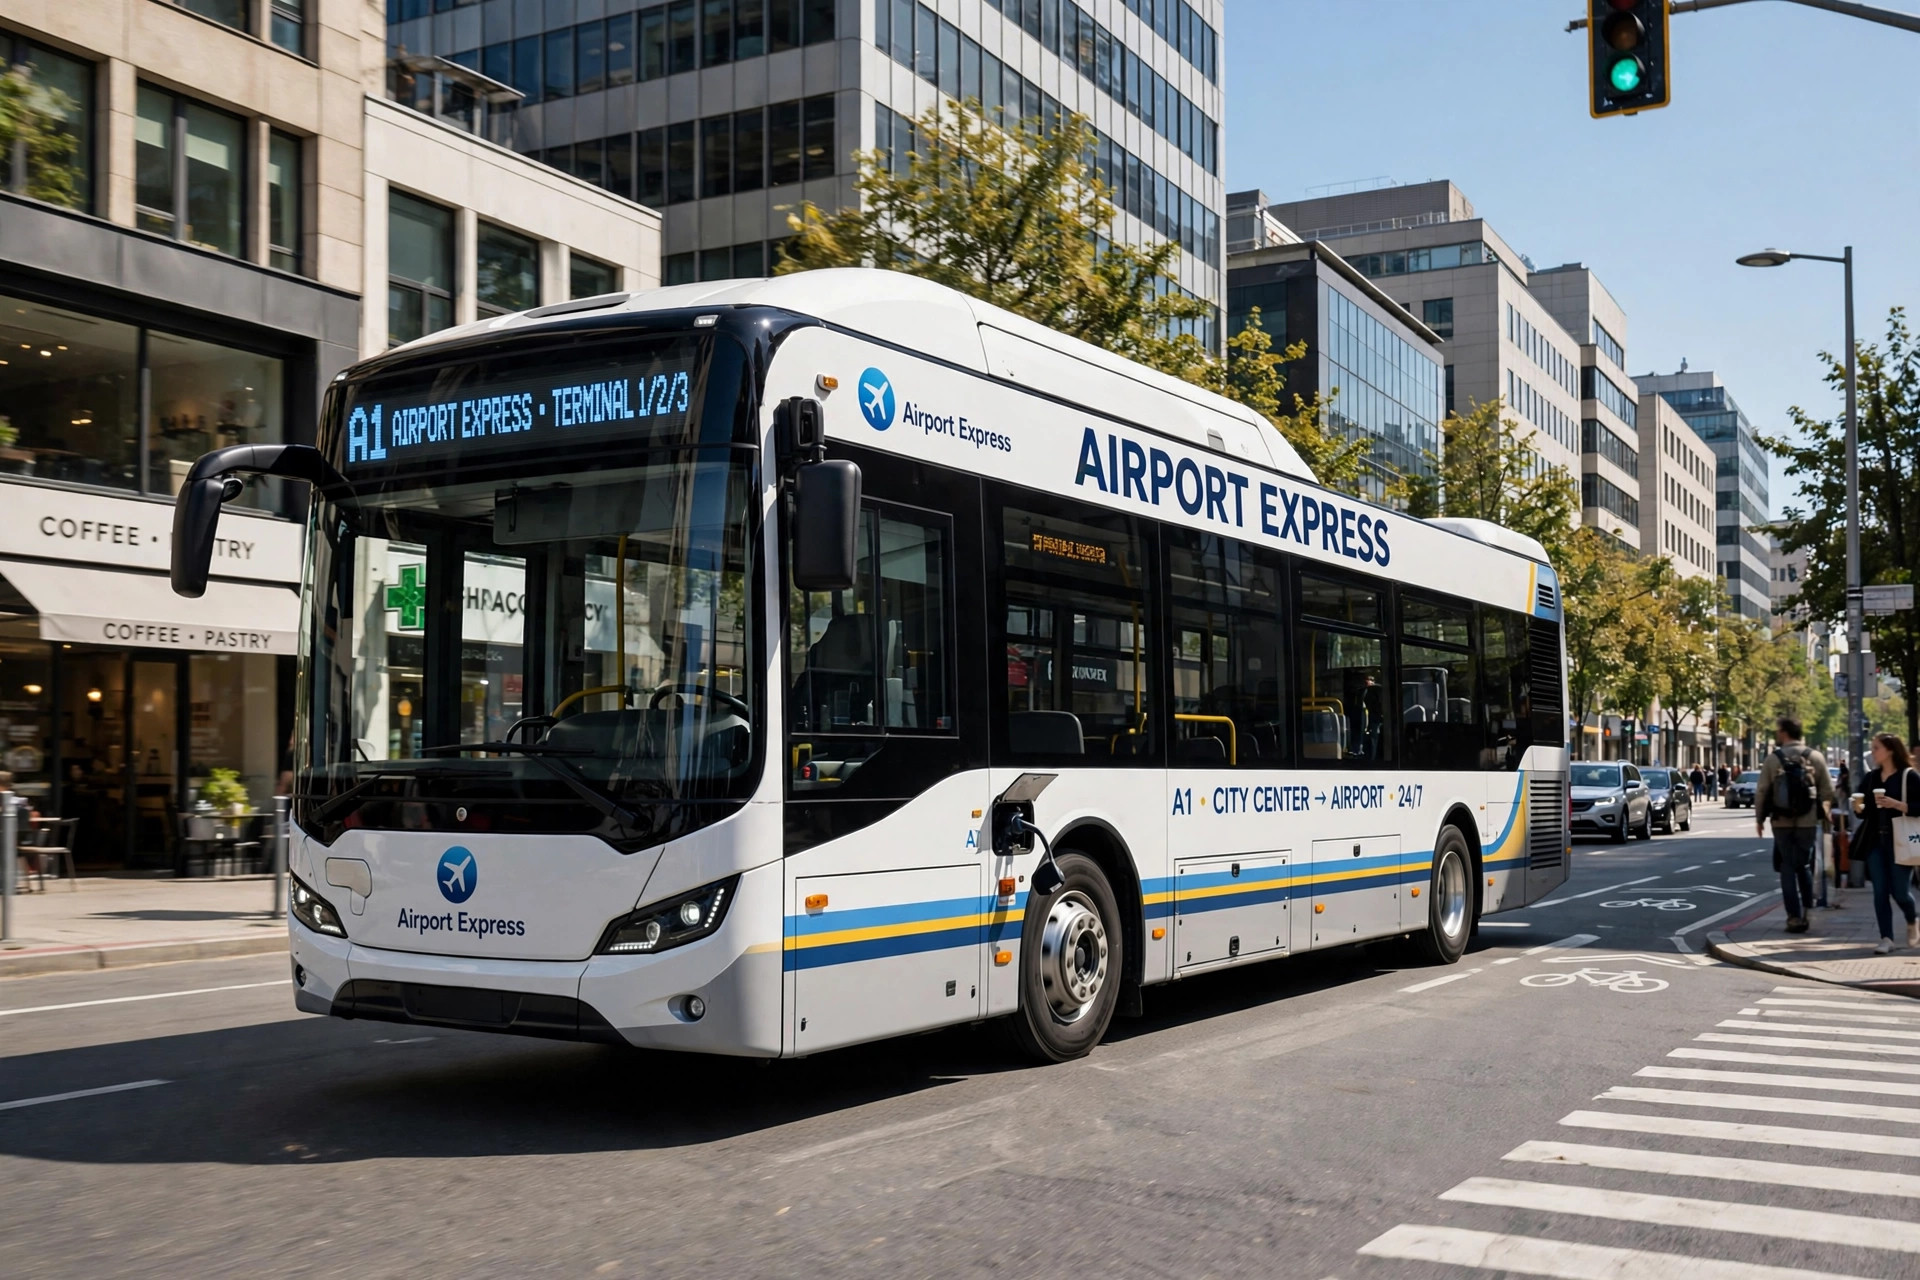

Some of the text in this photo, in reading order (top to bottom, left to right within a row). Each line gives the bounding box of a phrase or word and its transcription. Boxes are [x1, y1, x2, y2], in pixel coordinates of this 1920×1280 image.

[349, 371, 688, 462] A1 AIRPORT EXPRESS TERMINAL 1/2/3
[903, 401, 1012, 452] Airport Express
[1075, 427, 1391, 567] AIRPORT EXPRESS
[40, 516, 139, 546] COFFEE
[103, 622, 271, 649] COFFEE PASTRY
[1172, 784, 1423, 815] A1 CITY CENTER AIRPORT 24/7
[395, 907, 526, 939] Airport Express
